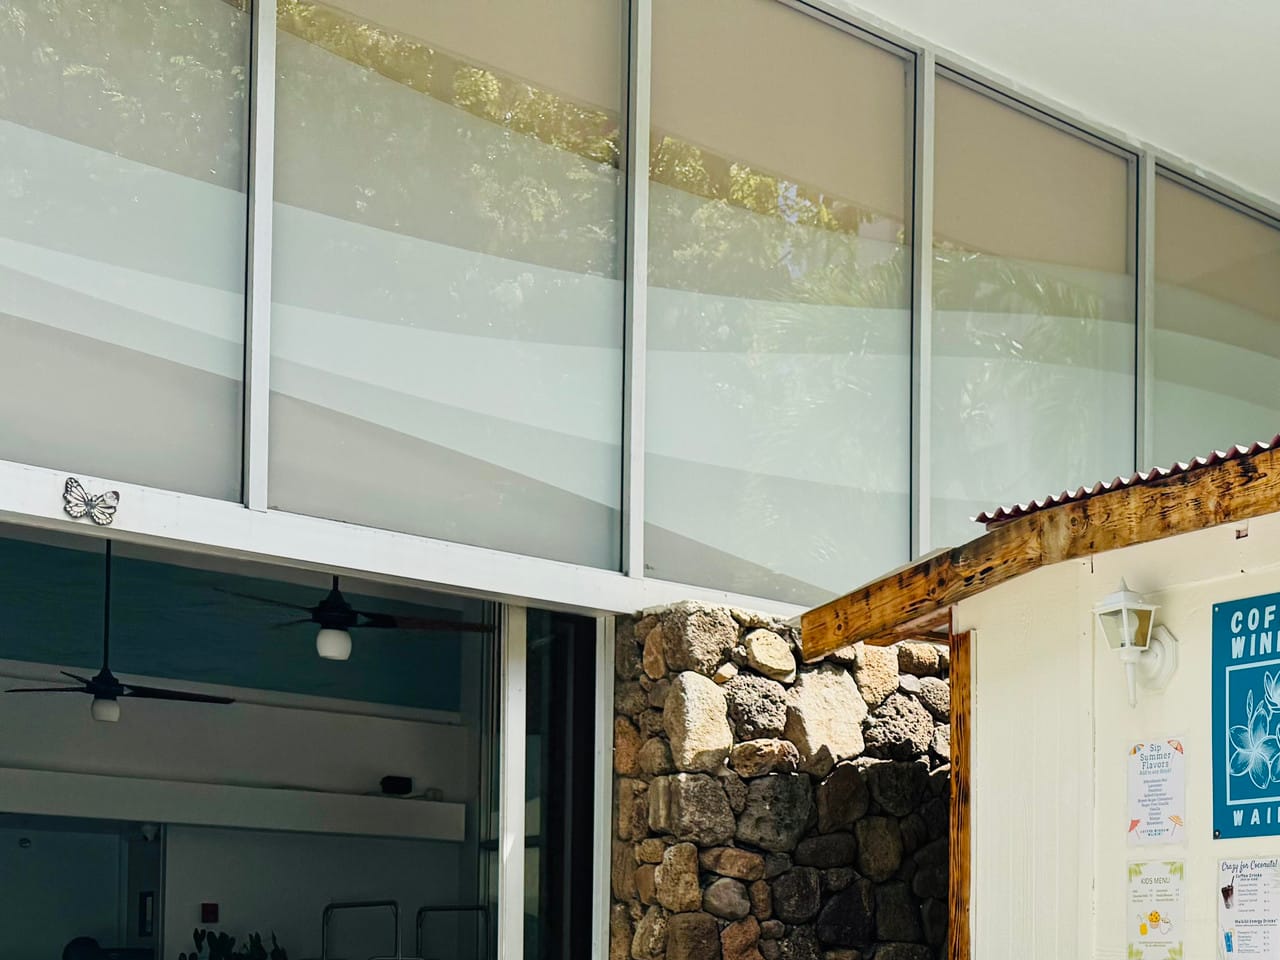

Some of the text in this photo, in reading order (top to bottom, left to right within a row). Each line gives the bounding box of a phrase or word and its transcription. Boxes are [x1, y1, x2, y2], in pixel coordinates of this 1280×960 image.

[1150, 743, 1161, 754] Sip
[1140, 752, 1171, 762] Summer
[1142, 761, 1169, 770] Flavors
[1221, 861, 1239, 873] Crazy
[1239, 860, 1249, 873] for
[1154, 876, 1171, 885] MENU
